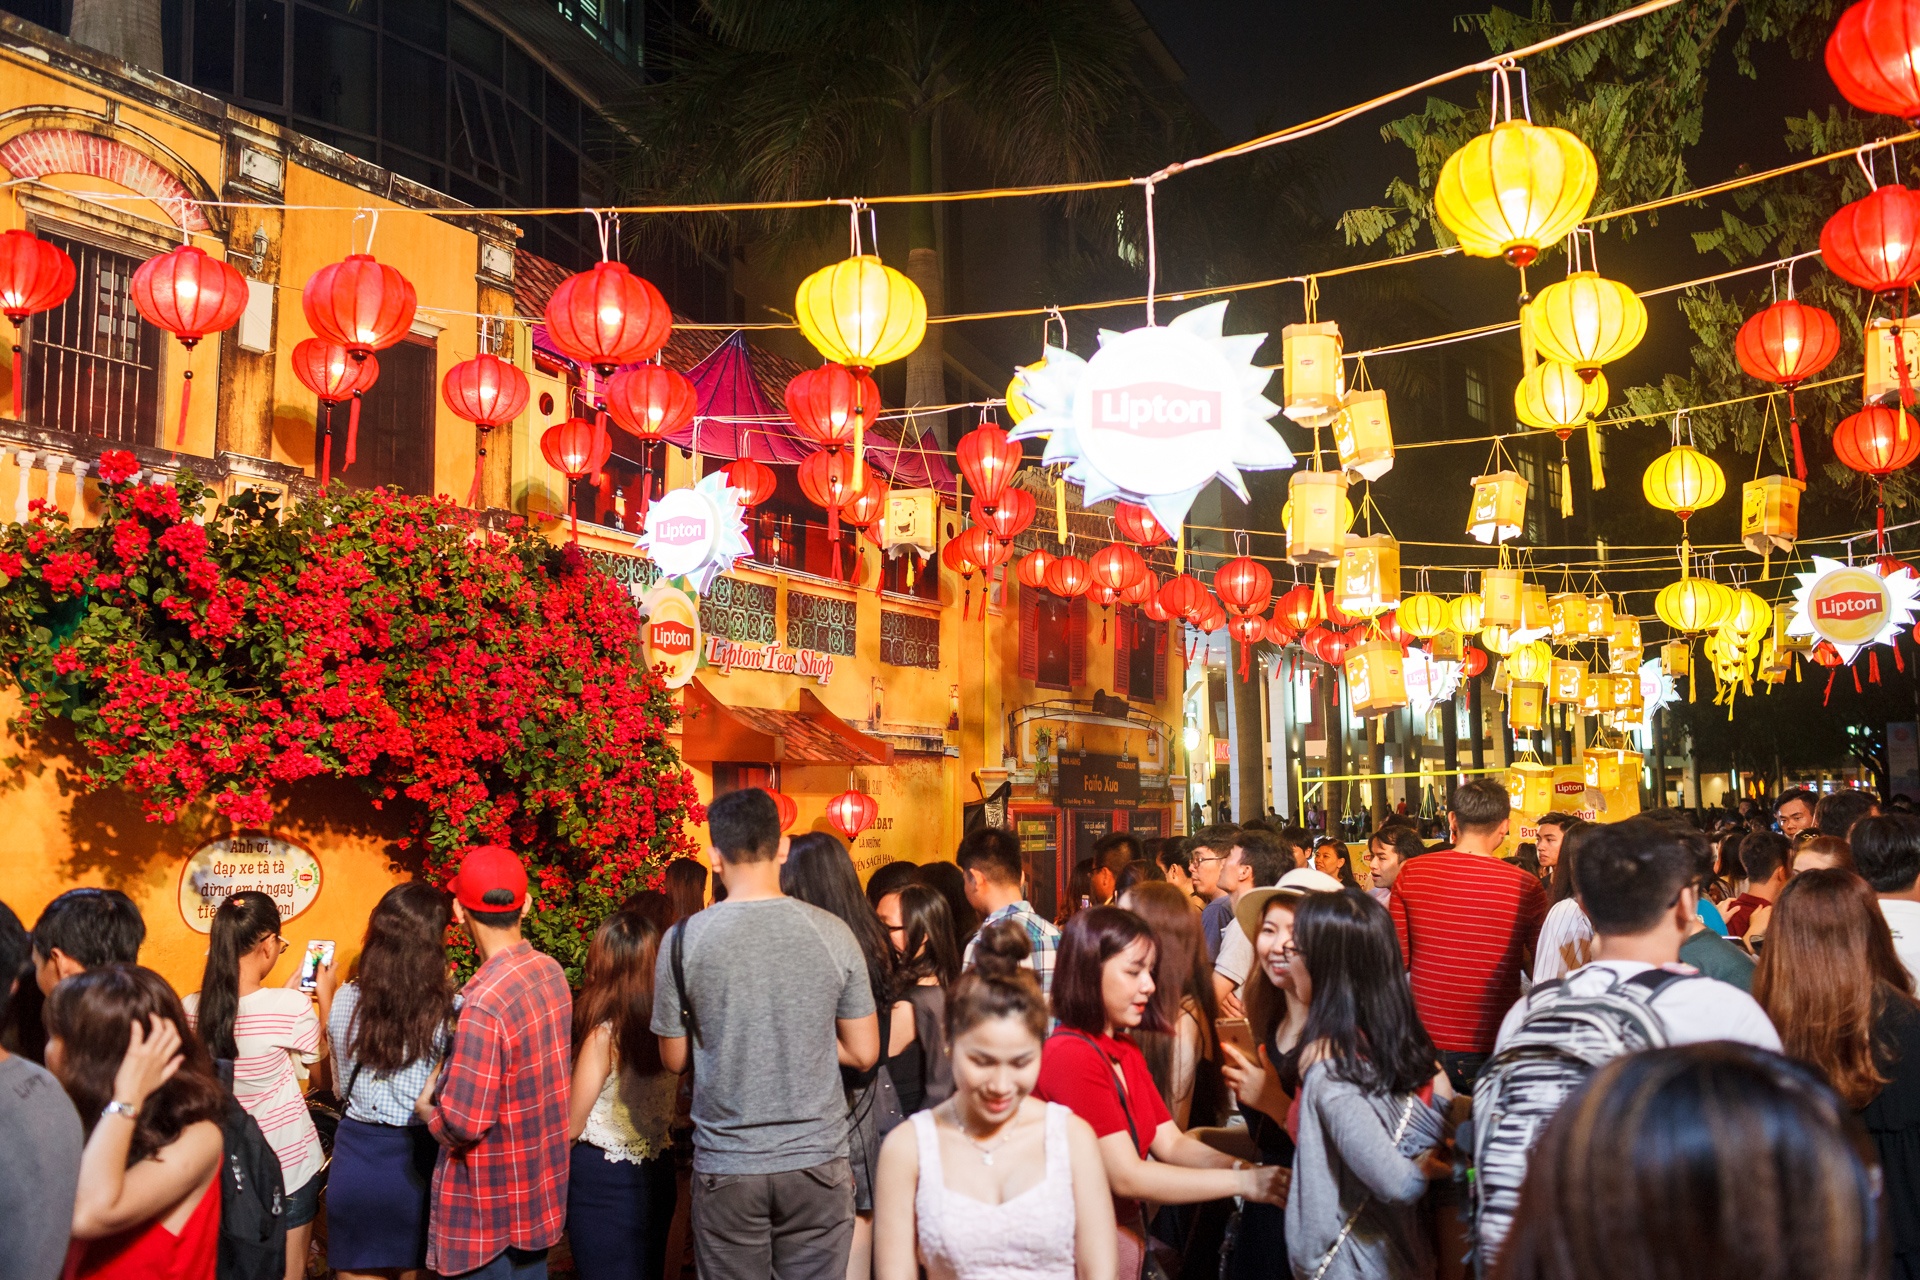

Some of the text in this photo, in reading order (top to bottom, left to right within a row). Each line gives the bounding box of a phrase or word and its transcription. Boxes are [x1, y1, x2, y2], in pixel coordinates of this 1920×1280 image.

[1101, 392, 1211, 430] Lipton
[659, 520, 702, 540] Lipton
[1821, 598, 1877, 616] Lipton
[654, 628, 691, 648] Lipton
[708, 637, 834, 683] Lipton Tea Shop
[1557, 784, 1583, 793] Lipton
[230, 840, 272, 855] Anh ơi,
[213, 860, 285, 879] đạp xe tà tà
[266, 882, 294, 898] ngay
